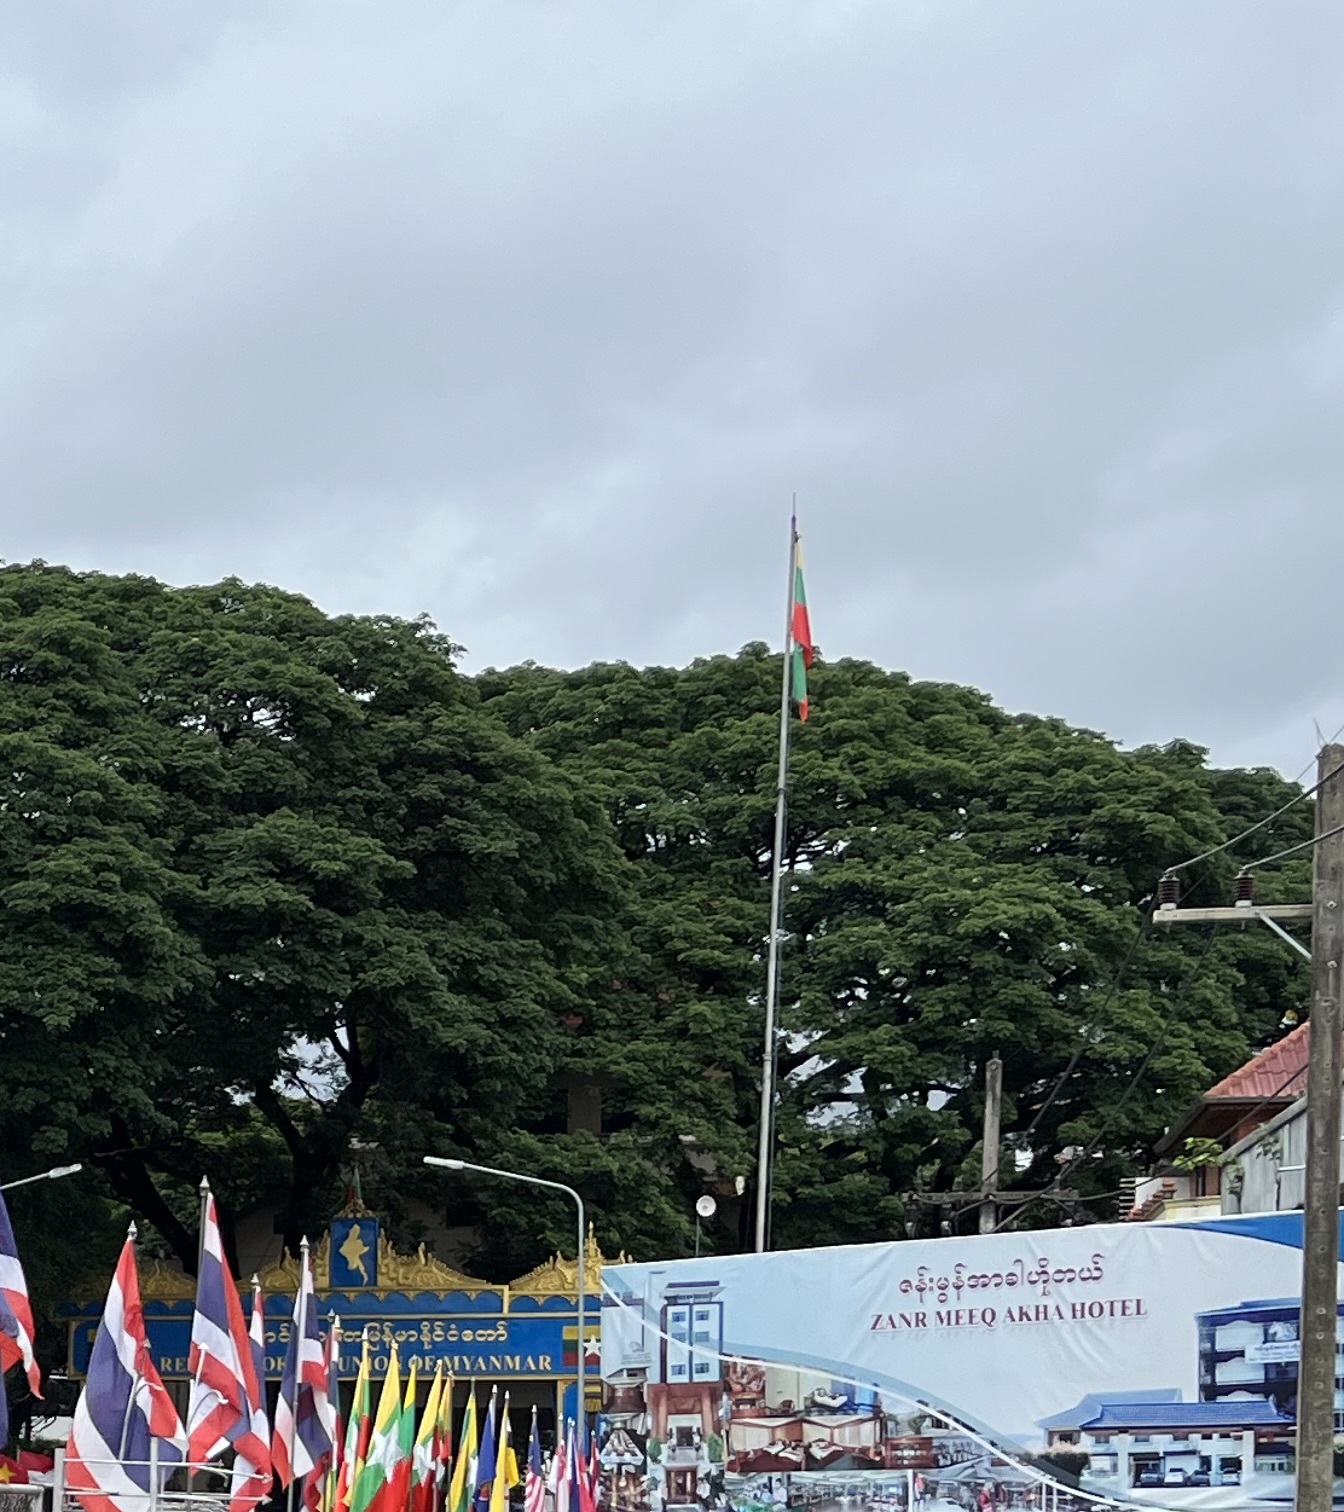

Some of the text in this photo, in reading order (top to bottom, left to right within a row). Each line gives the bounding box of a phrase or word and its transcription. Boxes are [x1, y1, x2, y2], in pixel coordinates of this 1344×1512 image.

[870, 1299, 1148, 1330] ZANR MEEQ AKHA HOTEL
[442, 1355, 552, 1371] MYANMAR
